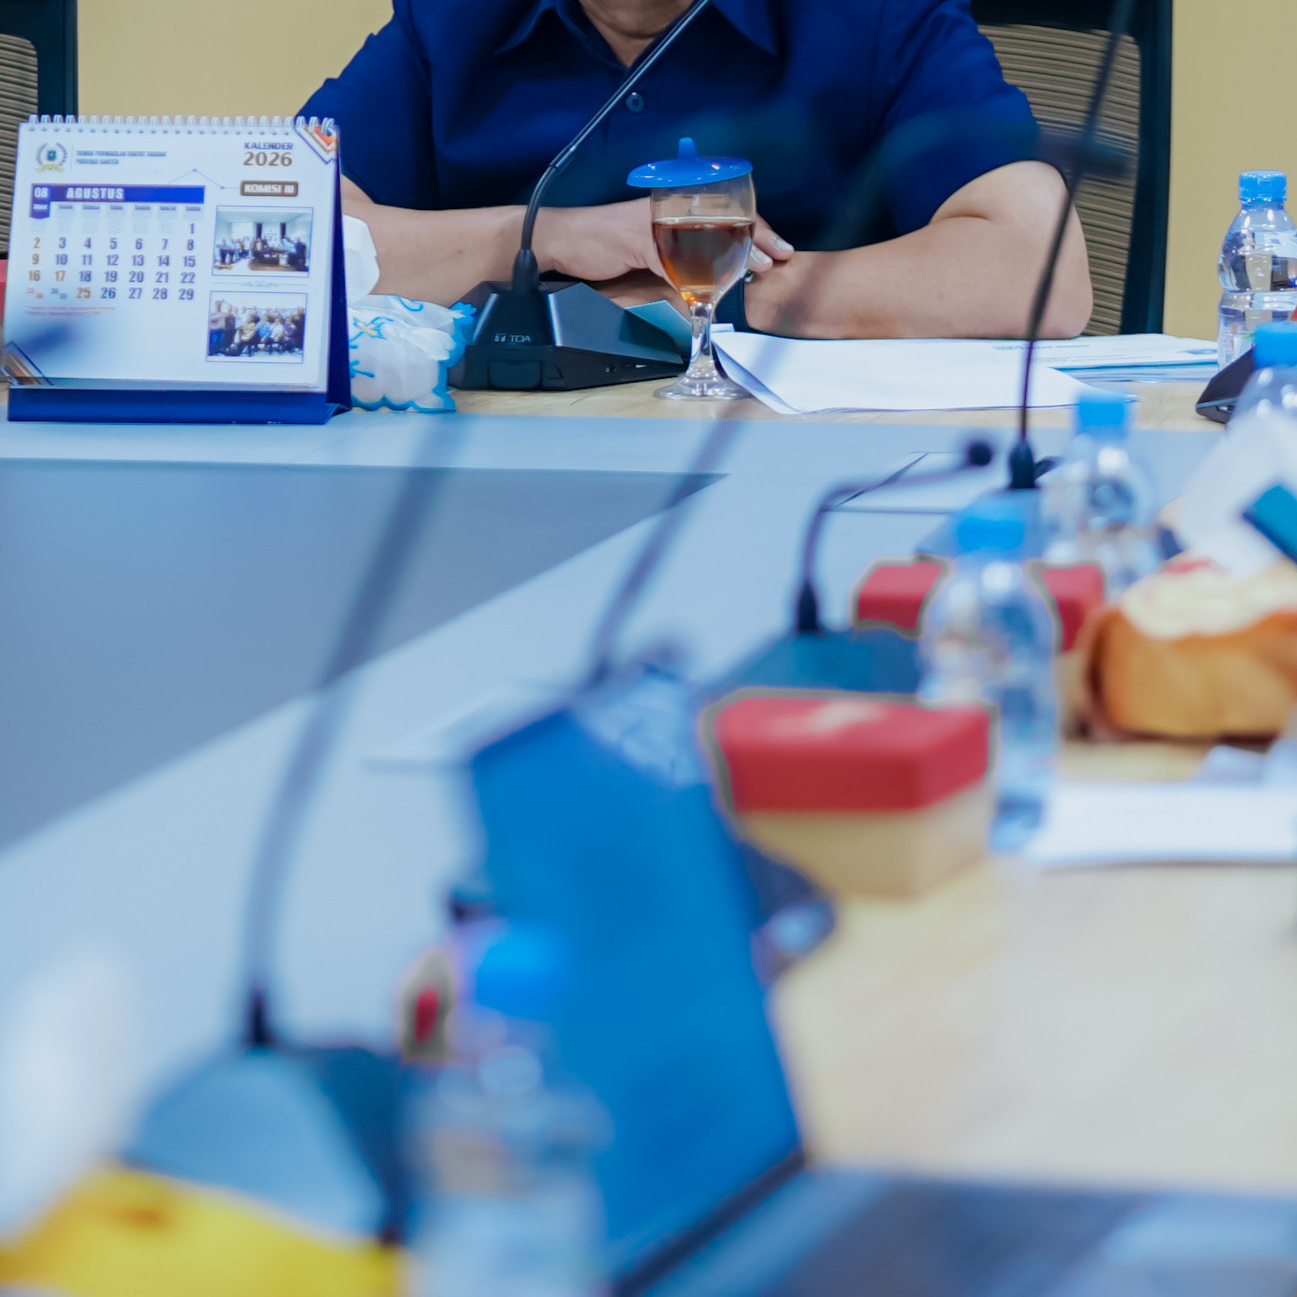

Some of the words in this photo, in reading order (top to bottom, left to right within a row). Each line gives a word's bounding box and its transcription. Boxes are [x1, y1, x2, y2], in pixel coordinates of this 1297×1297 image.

[244, 142, 293, 150] KALENDER
[242, 151, 293, 167] 2026
[33, 187, 48, 198] 08
[66, 187, 124, 199] AGUSTUS
[189, 222, 195, 234] 1
[33, 236, 41, 249] 2
[58, 236, 67, 249] 3
[84, 237, 92, 249] 4
[109, 237, 117, 249] 5
[135, 238, 143, 250] 6
[161, 238, 168, 250] 7
[186, 239, 194, 251] 8
[31, 253, 40, 265] 9
[54, 253, 68, 265] 10
[81, 254, 92, 265] 11
[106, 254, 119, 266] 12
[131, 254, 144, 266] 13
[157, 255, 170, 267] 14
[182, 255, 196, 267] 15
[28, 269, 41, 282] 16
[54, 270, 66, 282] 17
[79, 270, 92, 282] 18
[104, 270, 118, 282] 19
[128, 270, 144, 283] 20
[155, 271, 169, 283] 21
[180, 271, 195, 283] 22
[75, 286, 92, 299] 25
[100, 286, 116, 299] 26
[128, 287, 142, 299] 27
[152, 287, 168, 300] 28
[178, 288, 194, 300] 29
[509, 334, 531, 343] TOA
